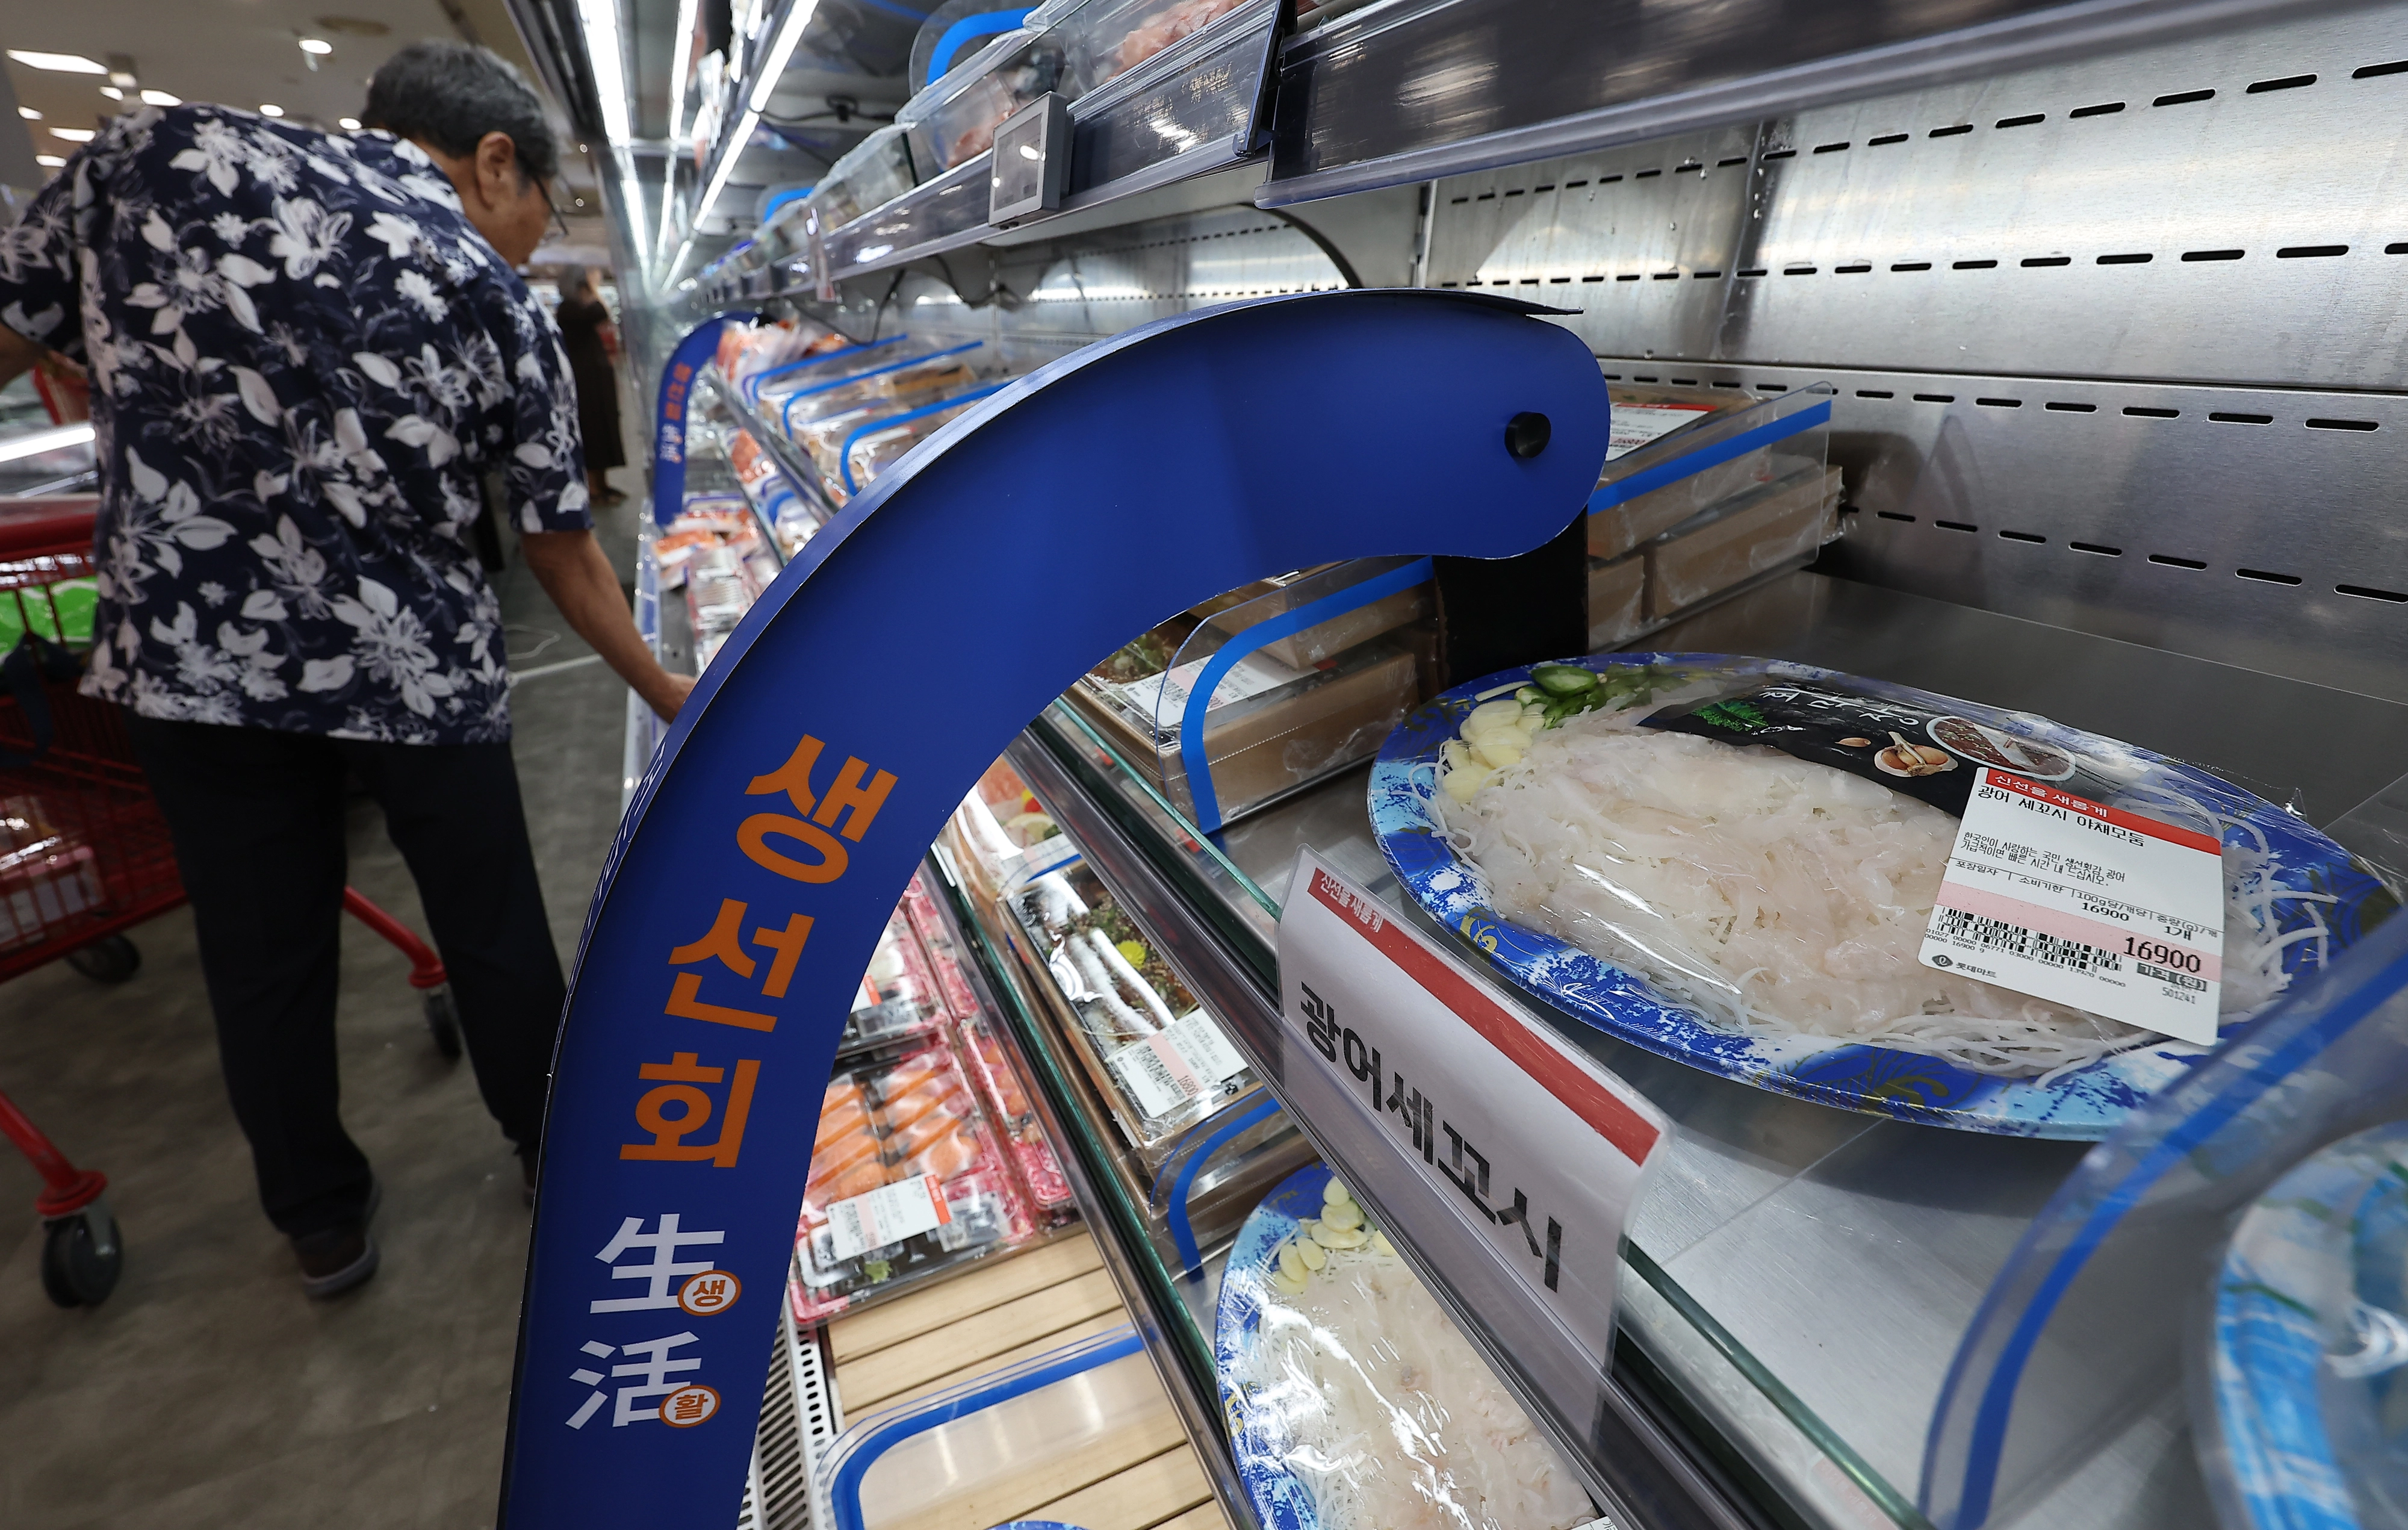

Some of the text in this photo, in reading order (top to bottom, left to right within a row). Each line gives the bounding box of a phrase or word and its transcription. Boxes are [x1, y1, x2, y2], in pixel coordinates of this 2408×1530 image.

[1978, 785, 2145, 847] 광어 세꼬시 야채모둠
[1994, 775, 2107, 818] 신선을 새롭게
[1955, 861, 1999, 876] 포장일자
[1961, 840, 2109, 886] 가급적이면 빠른 시간 내 드십시오.
[1964, 832, 2126, 882] 한국인이 사랑하는 국민 생선횟감 광어
[1320, 874, 1384, 933] 신선을 새롭게
[2019, 877, 2064, 894] 소비기한
[2081, 902, 2130, 921] 16900
[619, 733, 899, 1168] 생선회
[1925, 933, 1947, 944] 00000
[1952, 941, 1975, 951] 16900
[2164, 926, 2192, 941] 1개
[1926, 928, 1949, 938] 01027
[1953, 934, 1977, 945] 00000
[1981, 942, 2005, 953] 06771
[2009, 950, 2034, 962] 03000
[2038, 959, 2064, 969] 00000
[2099, 975, 2126, 987] 00000
[1955, 962, 1997, 978] 롯데마트
[2123, 936, 2202, 974] 16900
[1300, 981, 1562, 1293] 광어세꼬시
[692, 1280, 726, 1307] 생
[565, 1213, 725, 1430] 生活
[674, 1393, 709, 1420] 활
